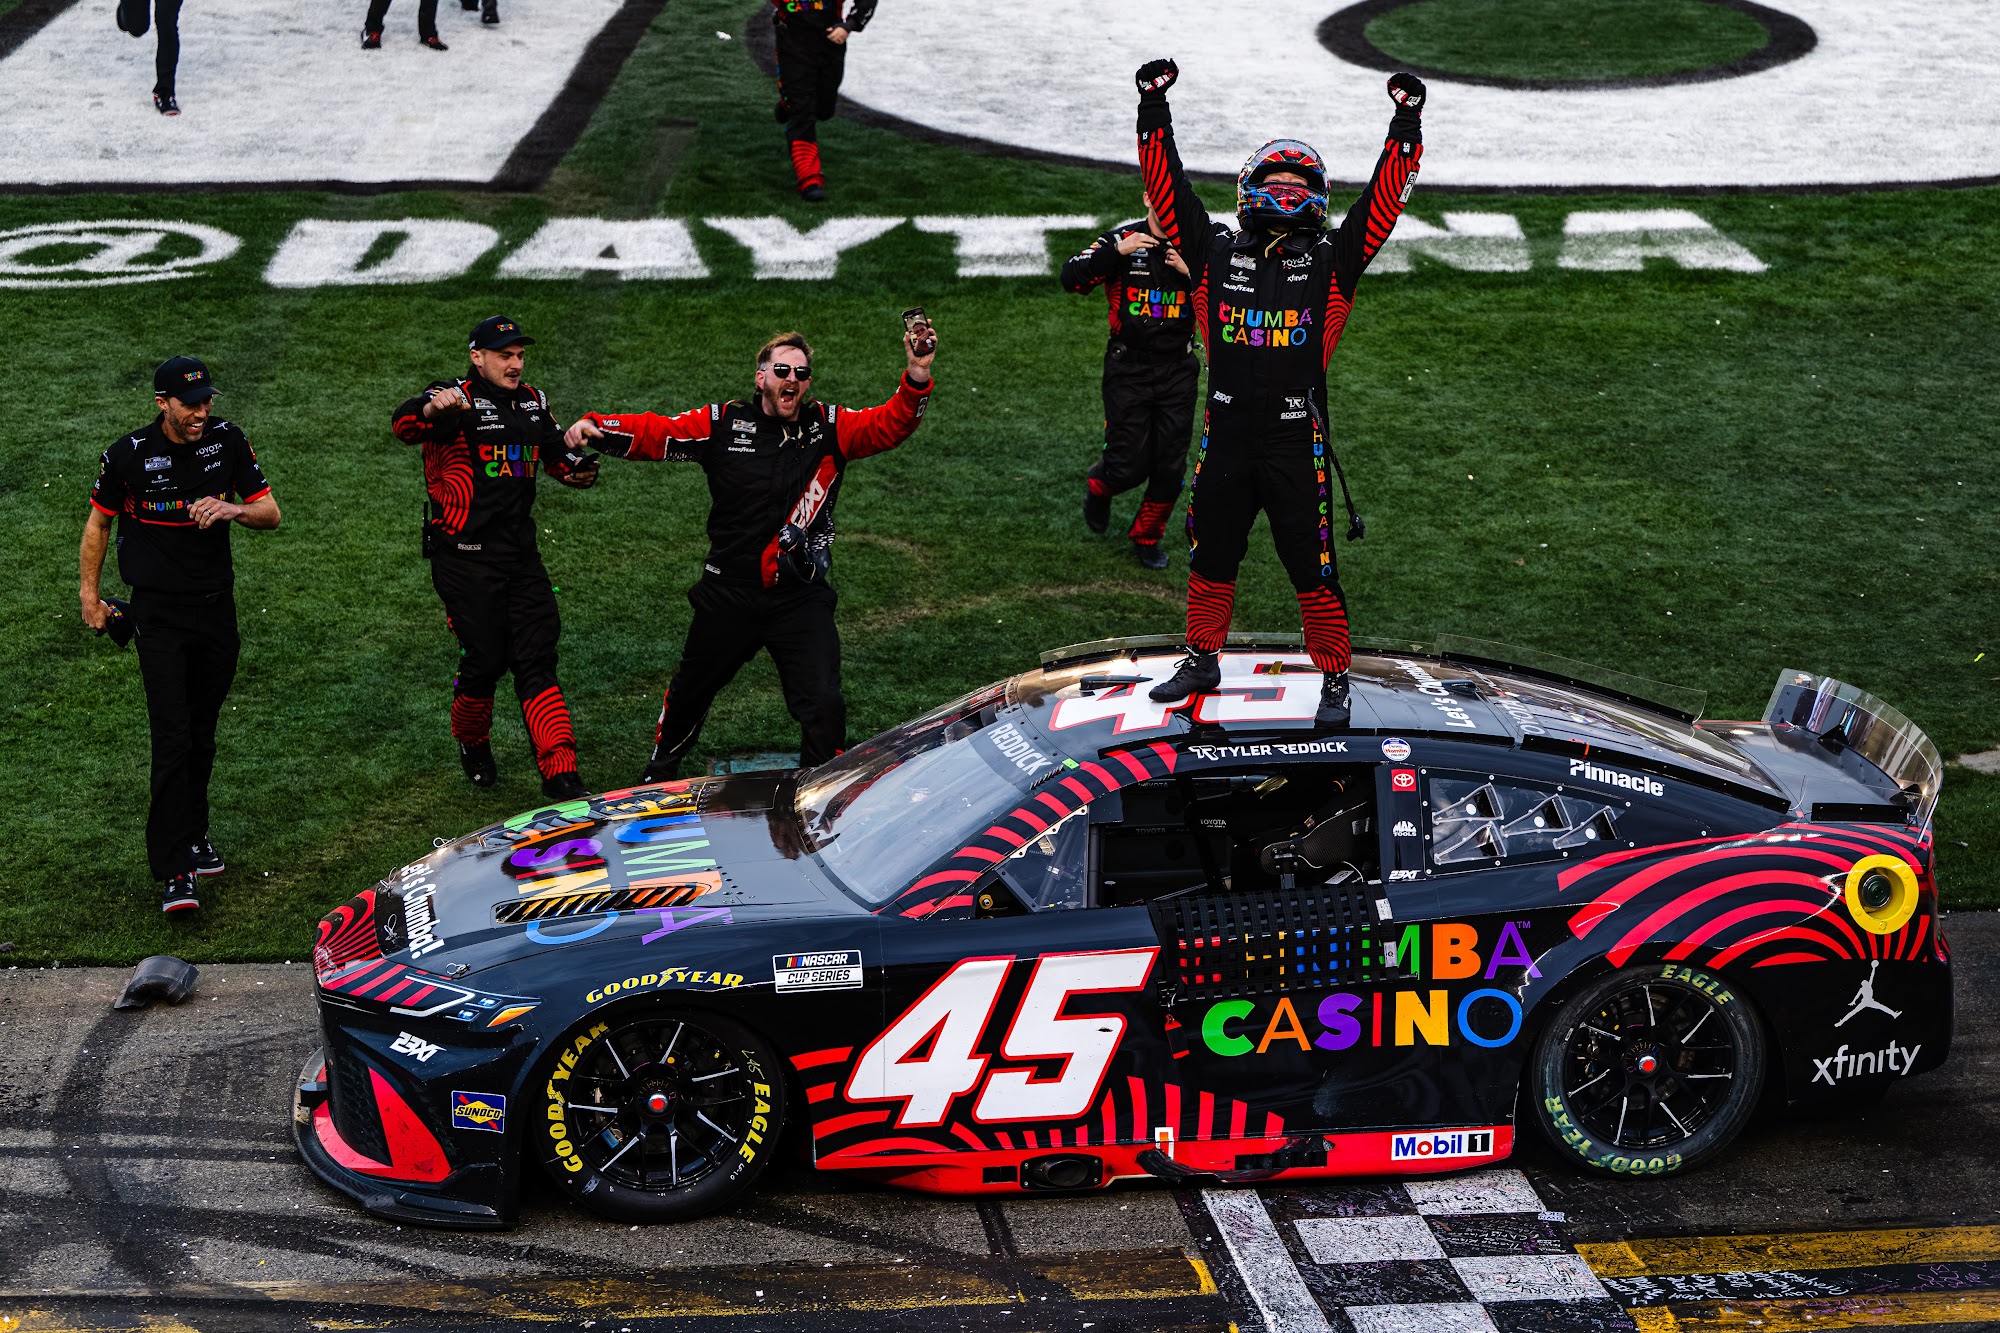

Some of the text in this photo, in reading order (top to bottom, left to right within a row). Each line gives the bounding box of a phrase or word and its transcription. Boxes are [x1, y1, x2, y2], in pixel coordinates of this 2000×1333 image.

[1127, 286, 1186, 304] CHUMB
[1128, 302, 1189, 318] CASINO
[1218, 301, 1313, 328] CHUMBA
[1222, 324, 1307, 347] CASINO
[1280, 410, 1307, 420] sparco
[195, 442, 222, 455] TOYOTA
[1318, 501, 1332, 577] CASINO
[987, 722, 1053, 776] REDDICK
[1217, 745, 1273, 757] TYLER
[1272, 741, 1348, 754] REDDICK
[1569, 758, 1664, 797] Pinnacle
[403, 883, 445, 959] Chumba!
[801, 953, 849, 967] NASCAR
[586, 966, 744, 1003] GOODYEAR
[787, 970, 851, 984] CUP SERIES
[1660, 964, 1735, 1005] EAGLE
[844, 946, 1161, 1129] 45
[1201, 988, 1523, 1056] CASINO
[389, 1031, 447, 1062] 23XI
[1812, 1040, 1922, 1086] xfinity
[456, 1105, 502, 1120] SUNOCO
[546, 1021, 609, 1173] GOODYEAR
[738, 1082, 771, 1163] EAGLE
[1394, 1134, 1483, 1156] Mobil 1
